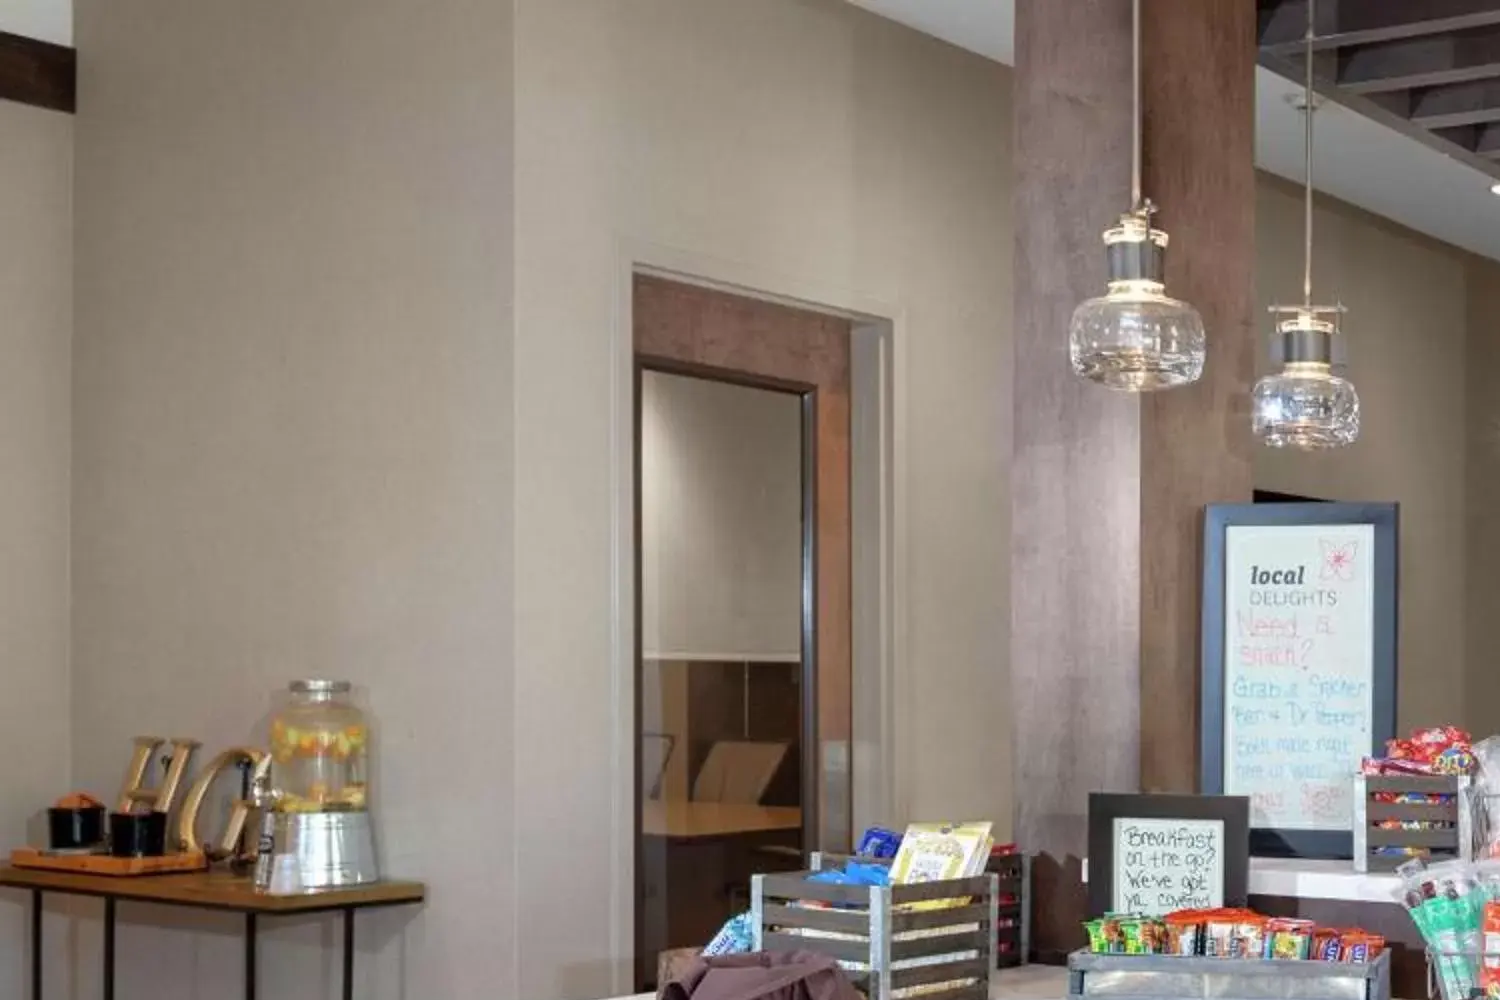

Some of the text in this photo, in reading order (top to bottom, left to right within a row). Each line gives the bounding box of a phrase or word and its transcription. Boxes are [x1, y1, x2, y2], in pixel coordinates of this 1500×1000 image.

[1250, 565, 1305, 585] local
[1249, 589, 1338, 606] DELIGHTS
[1233, 676, 1282, 698] Grab
[1124, 826, 1216, 850] Breakfast
[1126, 852, 1146, 867] on
[1150, 852, 1181, 868] the
[1126, 869, 1209, 896] We've got
